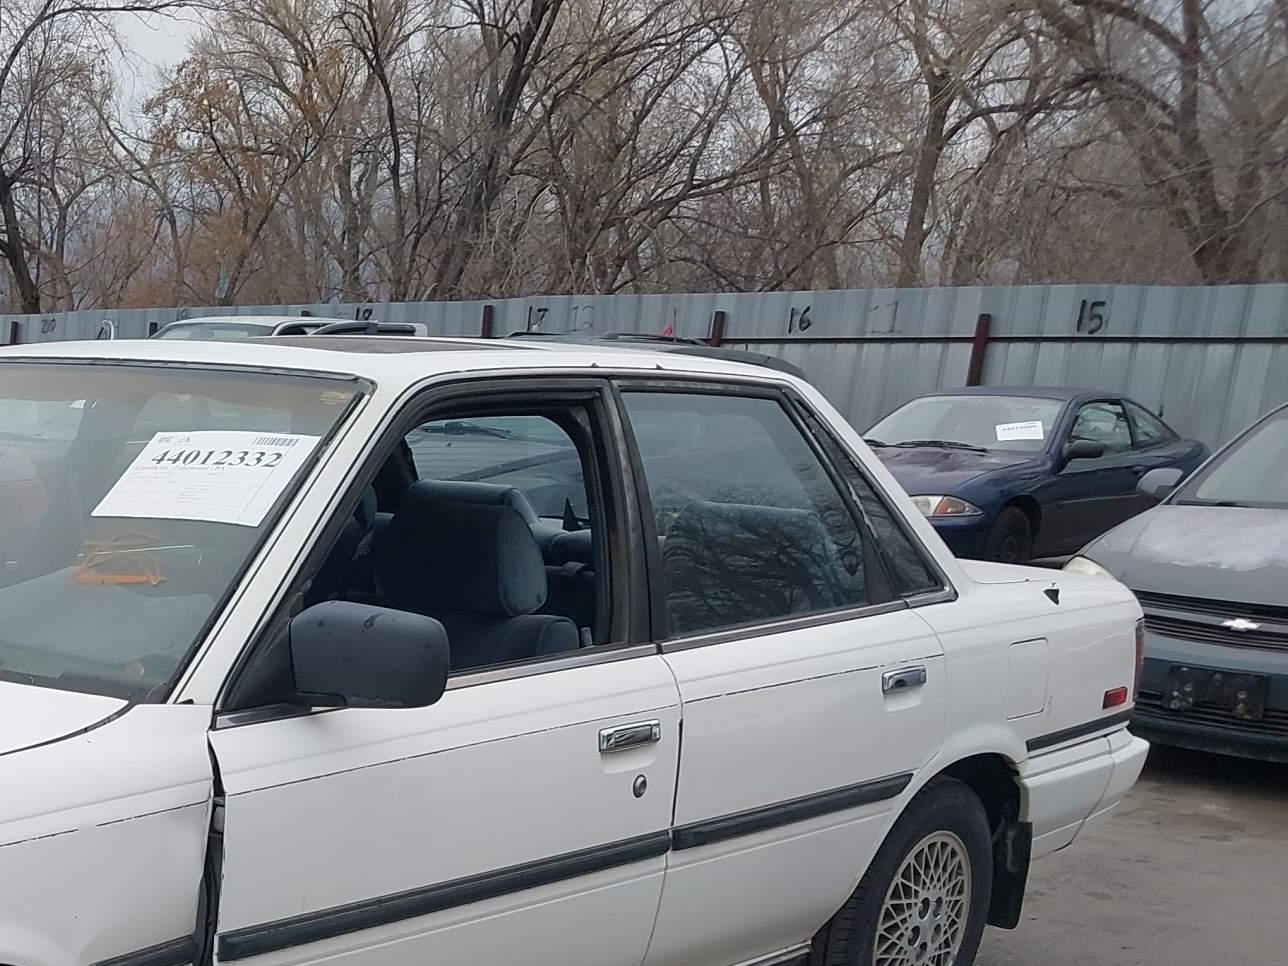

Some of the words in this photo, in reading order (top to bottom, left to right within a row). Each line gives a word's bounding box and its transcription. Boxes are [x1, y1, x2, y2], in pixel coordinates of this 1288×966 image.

[40, 317, 57, 334] 20
[527, 305, 549, 332] 17
[788, 305, 812, 334] 16
[1076, 298, 1106, 335] 15
[151, 449, 284, 469] 44012332
